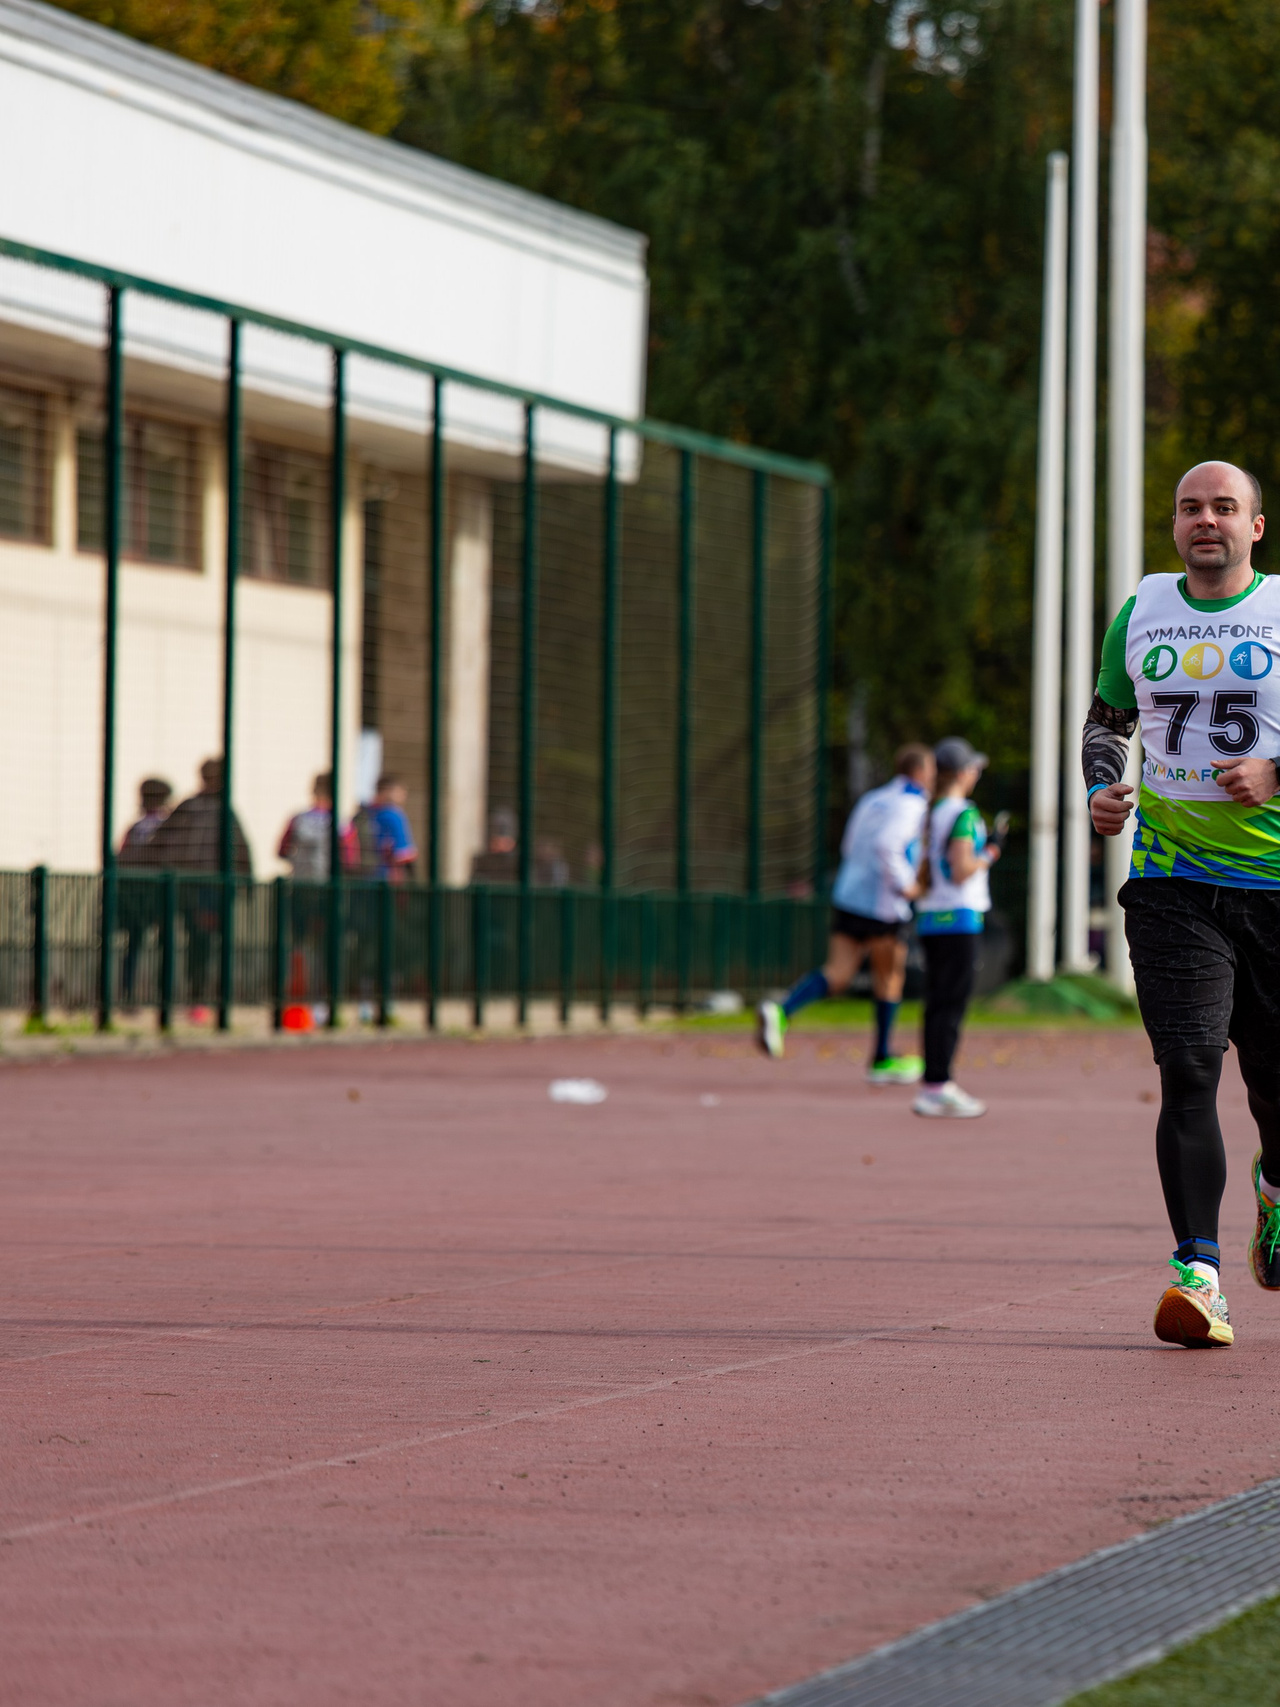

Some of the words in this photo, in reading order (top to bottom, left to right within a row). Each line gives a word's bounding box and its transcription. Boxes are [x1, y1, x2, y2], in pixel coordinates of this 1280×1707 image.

[1146, 624, 1273, 643] VMARAFONE
[1151, 690, 1260, 755] 75
[1152, 763, 1226, 782] VMARAFO
